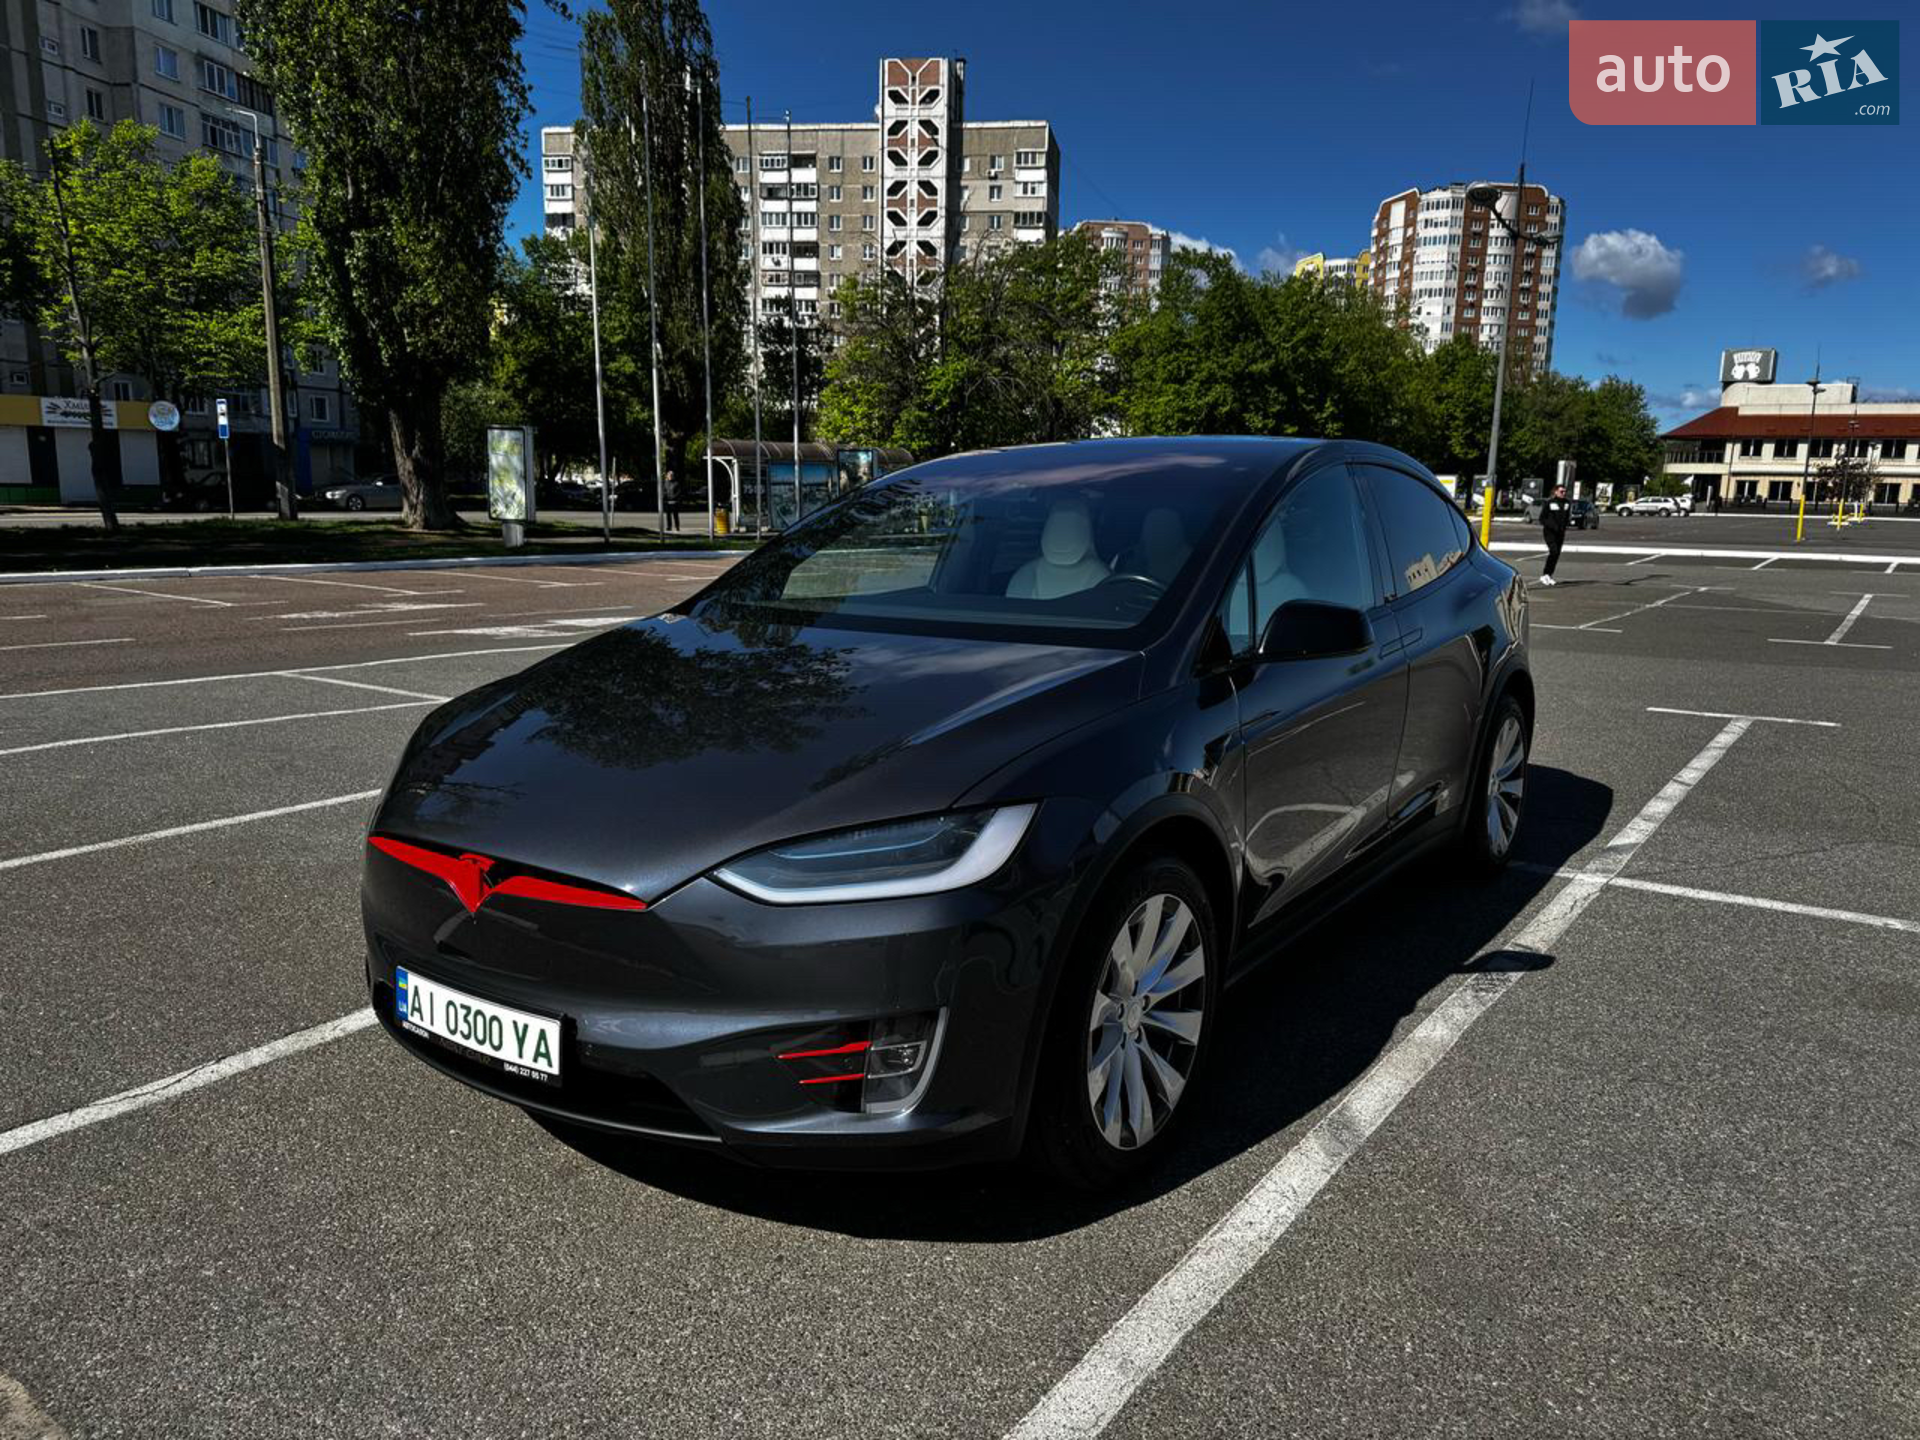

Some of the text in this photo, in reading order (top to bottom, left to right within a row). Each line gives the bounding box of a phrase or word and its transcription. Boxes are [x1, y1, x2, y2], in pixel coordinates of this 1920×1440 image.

[410, 985, 434, 1027] AI
[446, 1000, 503, 1051] 0300
[513, 1020, 553, 1068] YA
